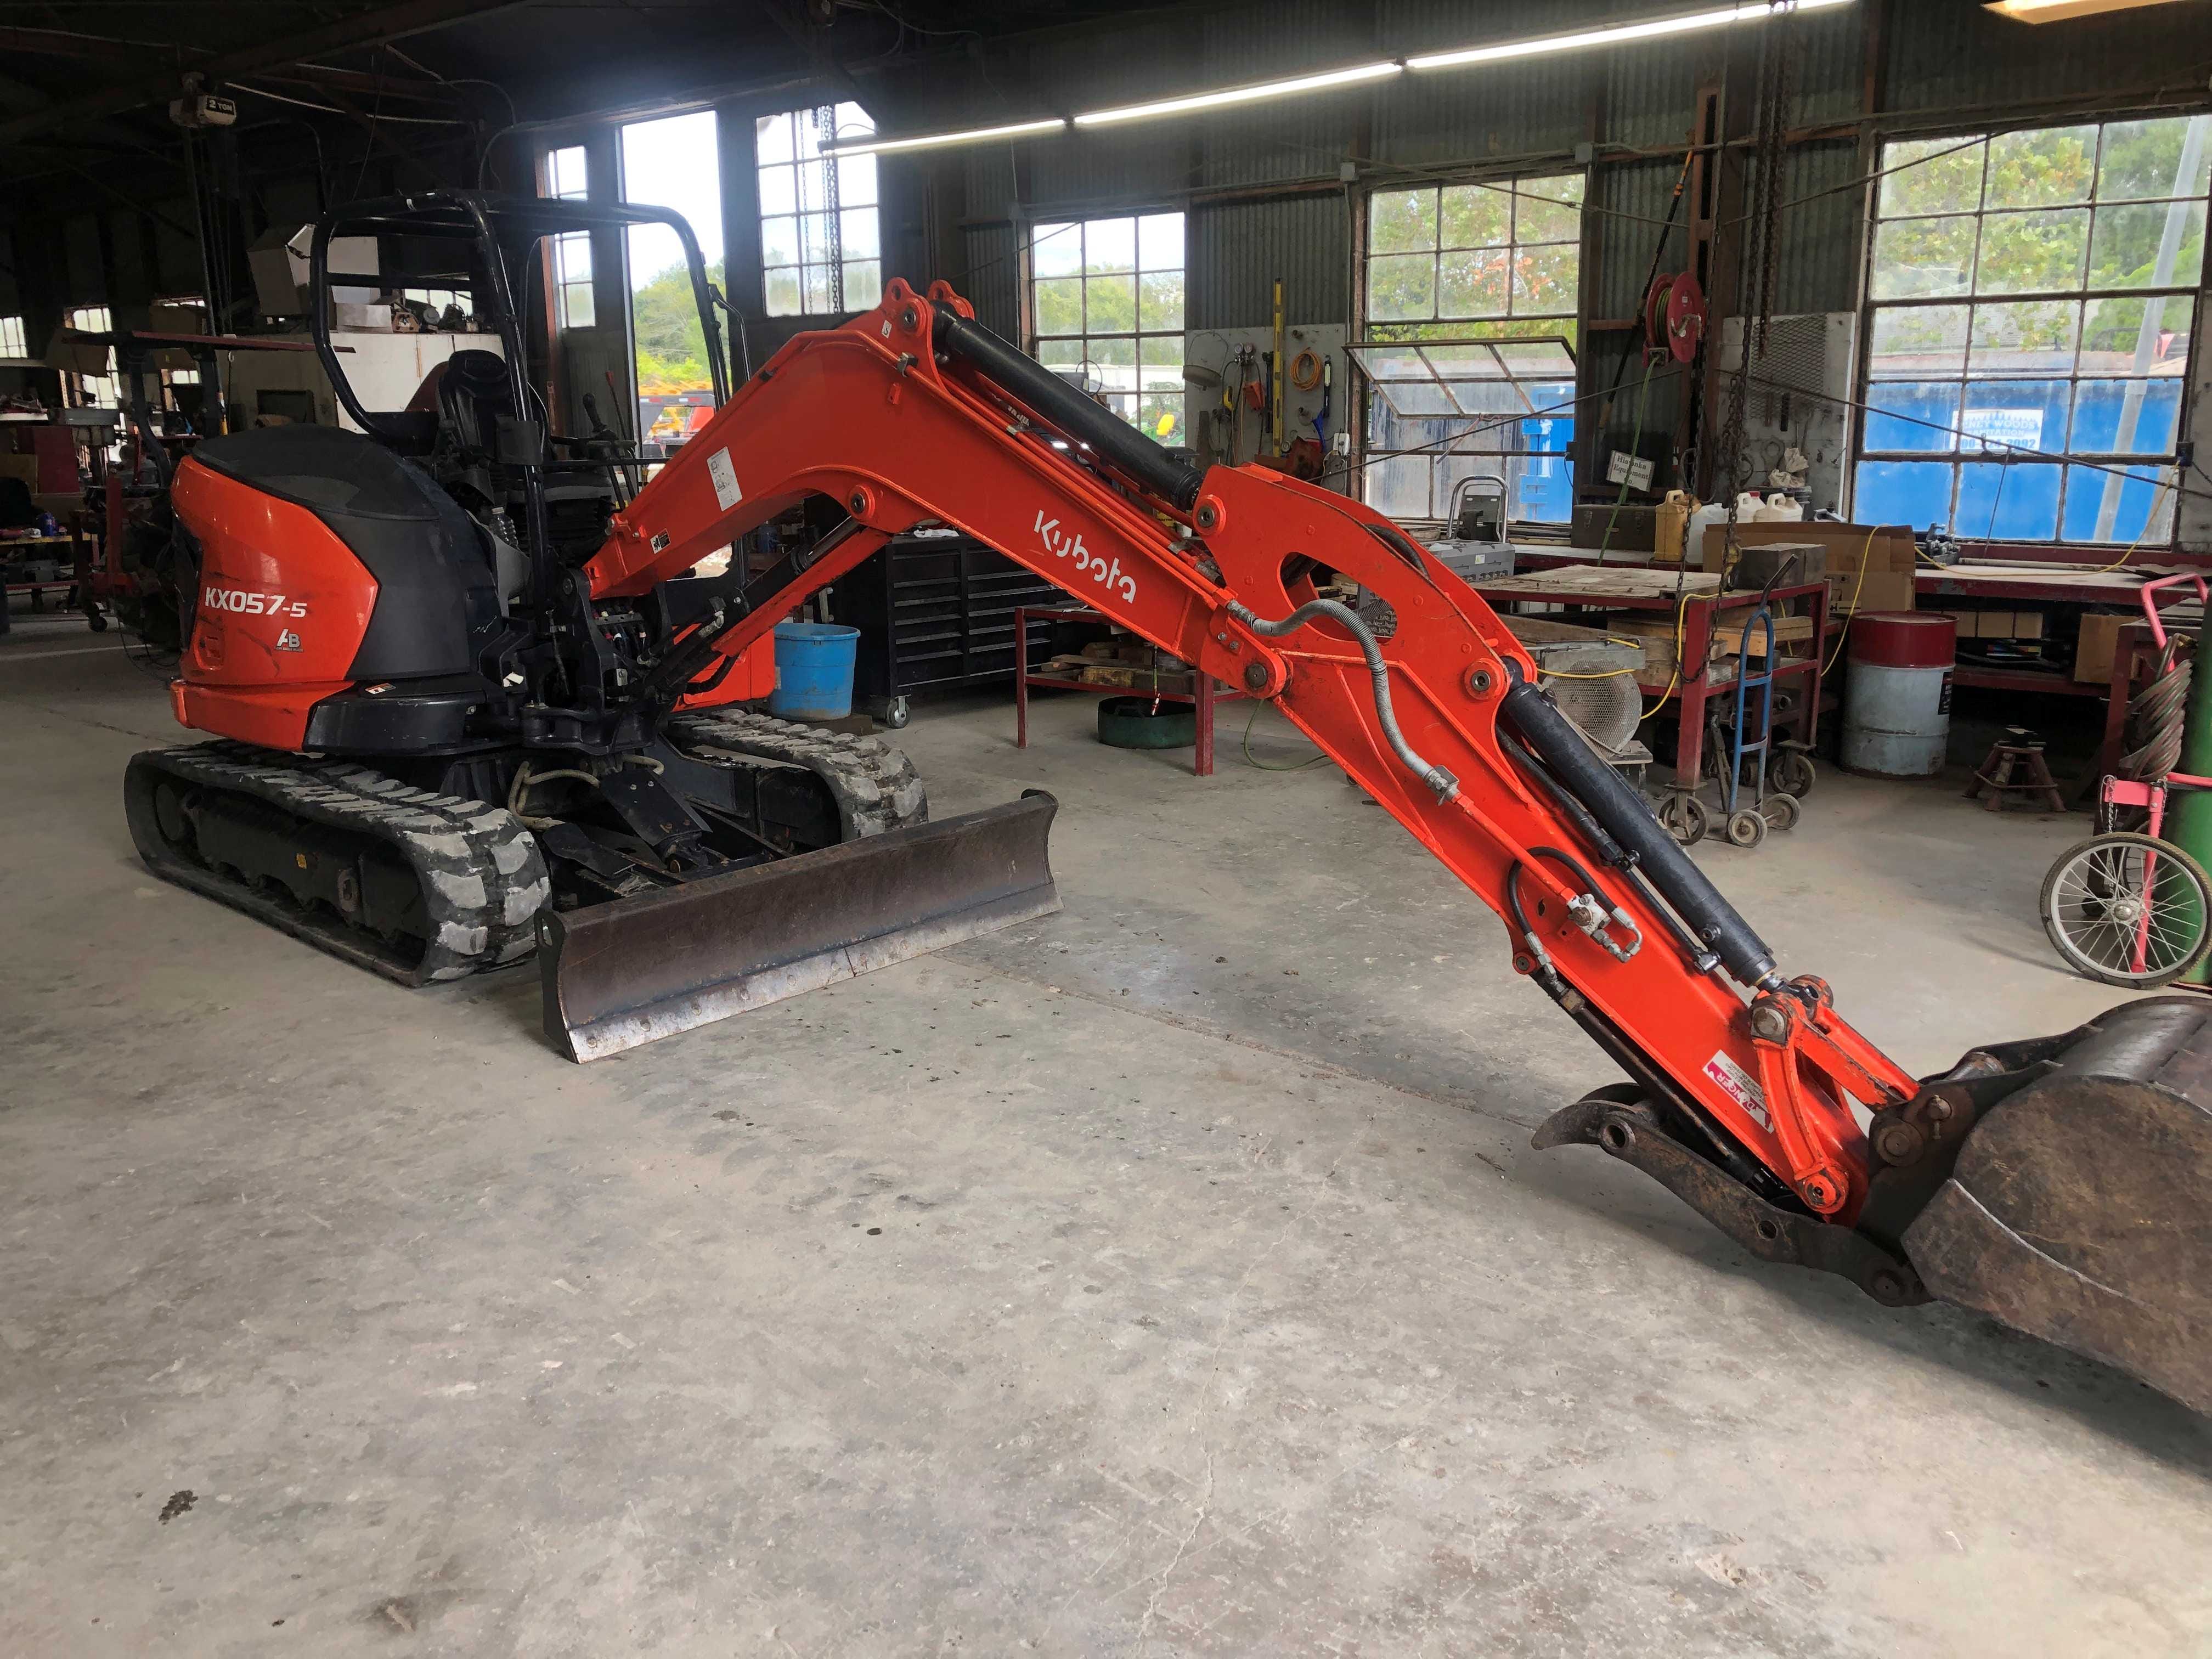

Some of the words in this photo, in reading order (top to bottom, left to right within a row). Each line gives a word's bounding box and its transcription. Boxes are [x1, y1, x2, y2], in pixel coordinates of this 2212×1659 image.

[210, 99, 216, 109] 2
[1994, 420, 2035, 430] WOODS
[1614, 464, 1649, 479] Equiment
[1034, 509, 1136, 604] Kubota
[205, 587, 307, 618] KX057-5
[1716, 1071, 1755, 1109] DNGER
